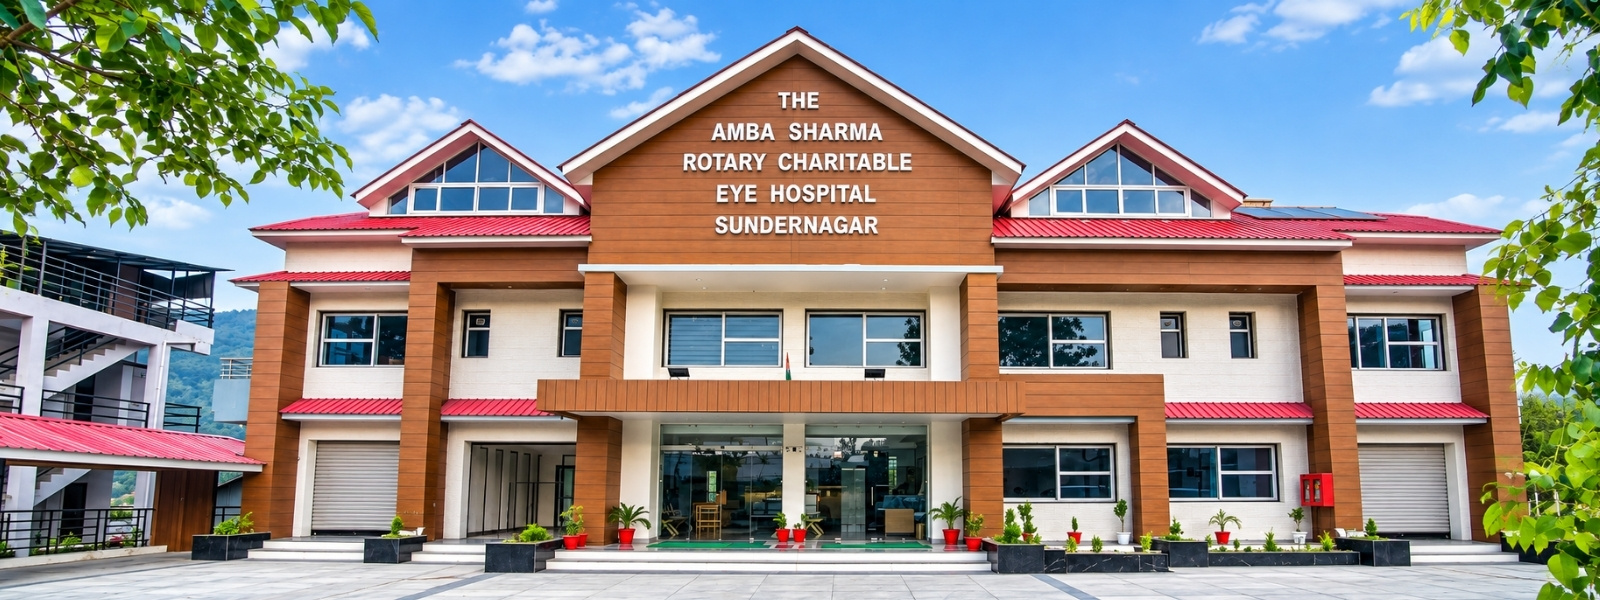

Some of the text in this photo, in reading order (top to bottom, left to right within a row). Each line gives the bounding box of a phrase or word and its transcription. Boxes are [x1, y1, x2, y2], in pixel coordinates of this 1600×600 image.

[778, 91, 820, 110] THE
[711, 122, 883, 142] AMBA SHARMA
[683, 152, 913, 172] ROTARY CHARITABLE
[716, 184, 877, 204] EYE HOSPITAL
[715, 215, 879, 235] SUNDERNAGAR
